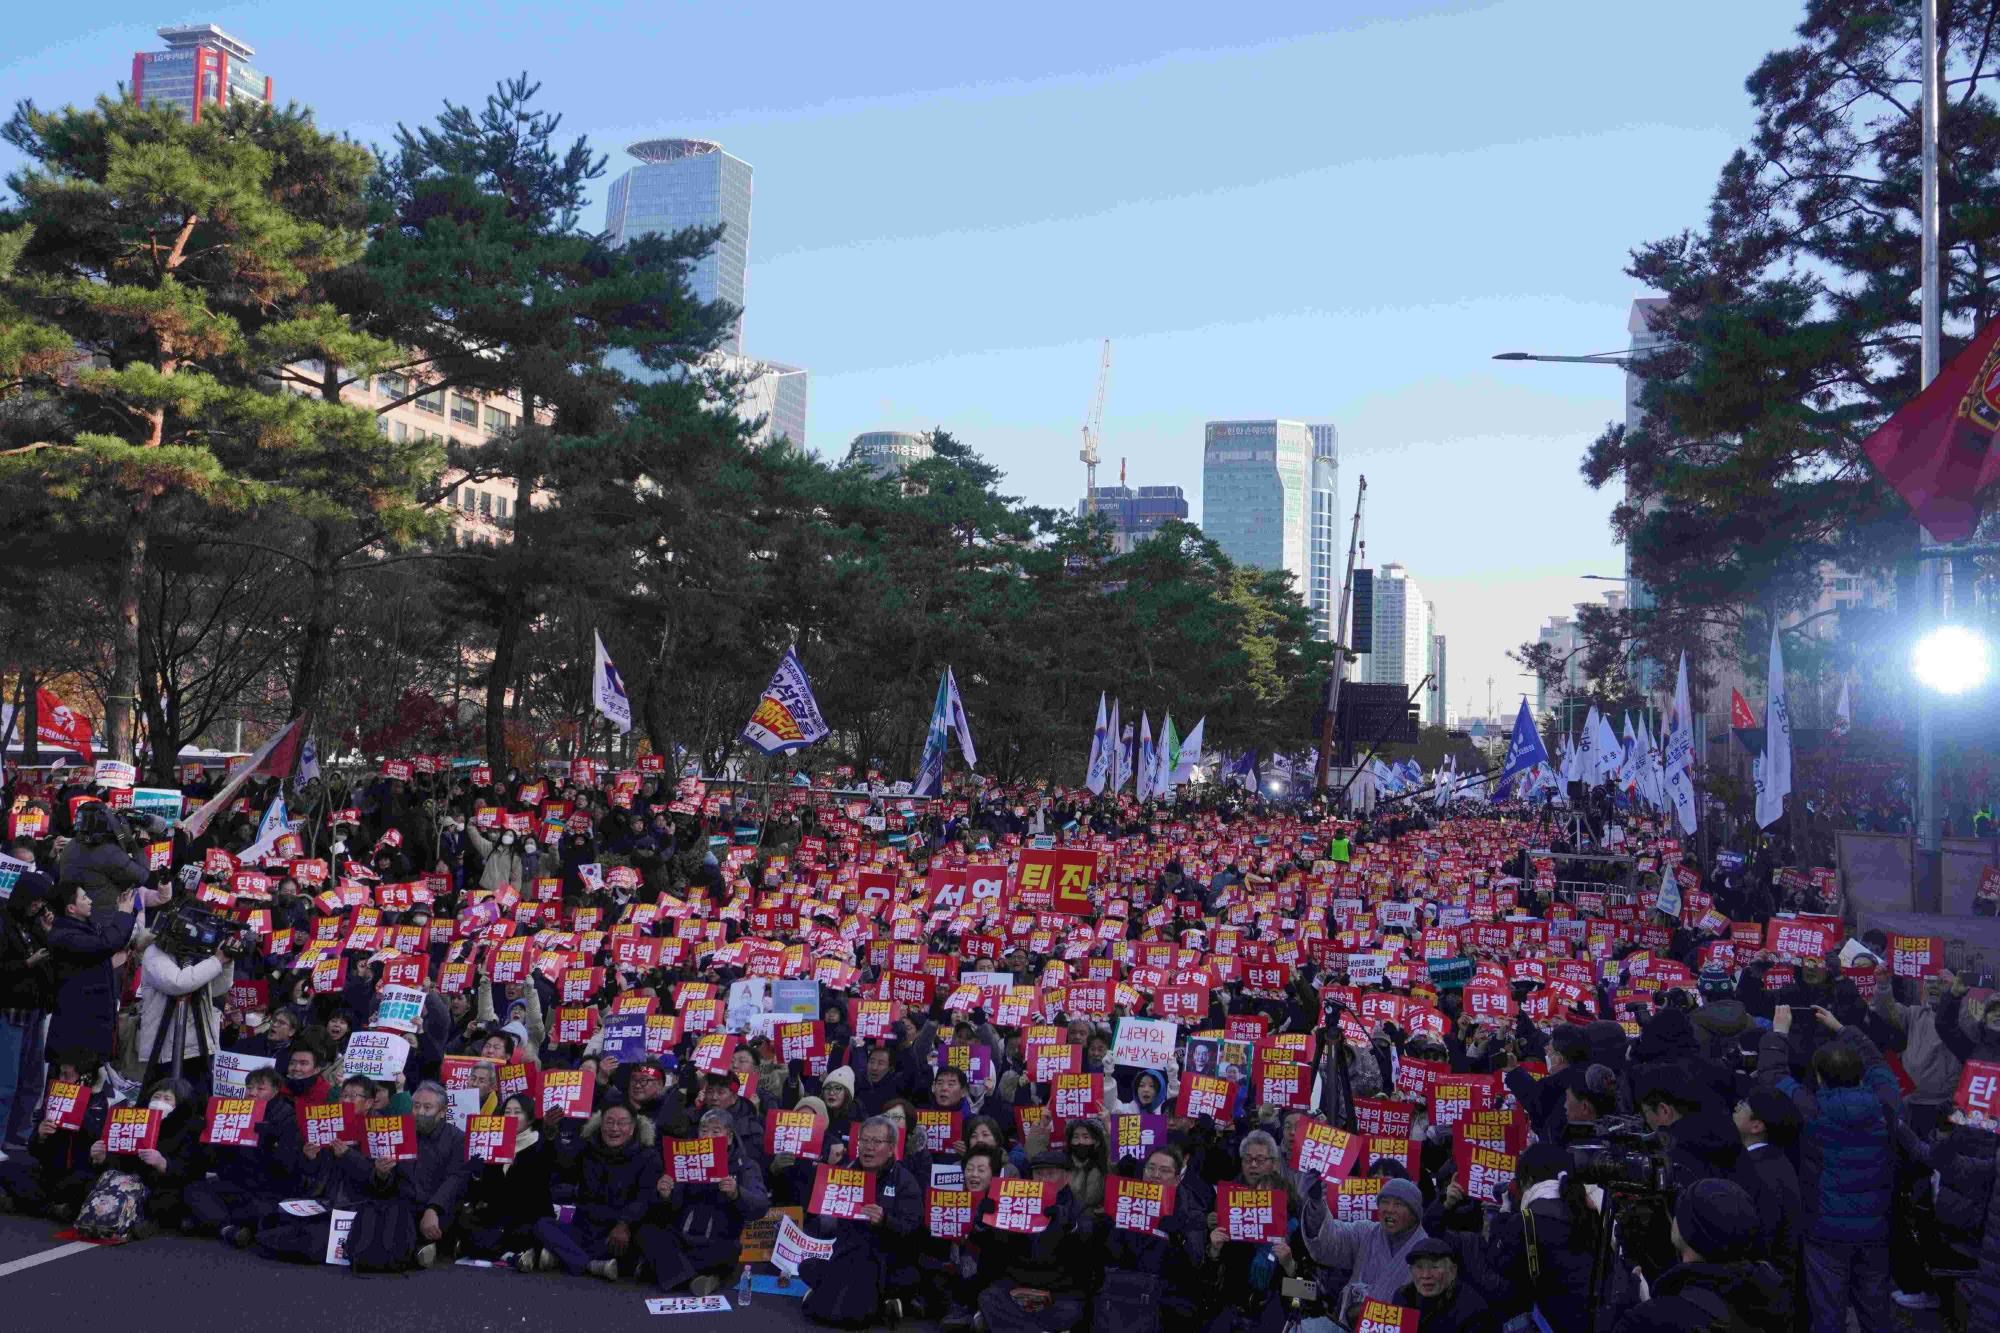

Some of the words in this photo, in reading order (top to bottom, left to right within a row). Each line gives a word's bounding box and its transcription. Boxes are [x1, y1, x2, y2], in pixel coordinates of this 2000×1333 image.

[295, 864, 321, 878] 탄핵
[236, 877, 265, 891] 탄핵
[1021, 864, 1093, 901] 퇴진
[382, 889, 407, 903] 탄핵
[774, 915, 794, 928] 탄핵
[1041, 916, 1064, 929] 탄핵
[398, 926, 422, 935] 내란죄
[1068, 928, 1091, 941] 탄핵
[1478, 928, 1507, 937] 윤석열을
[1778, 927, 1824, 944] 윤석열을
[397, 934, 421, 944] 윤석열
[661, 936, 682, 947] 내란죄
[1478, 936, 1507, 945] 탄핵하라
[1894, 937, 1930, 951] 내란죄
[396, 943, 413, 953] 탄핵!
[619, 943, 652, 959] 탄핵
[895, 944, 920, 955] 내란죄
[965, 941, 995, 956] 탄핵
[1777, 940, 1822, 956] 탄핵하라
[496, 951, 521, 962] 내란죄
[894, 955, 920, 964] 윤석열
[1893, 950, 1930, 965] 윤석열
[314, 960, 340, 973] 내란죄
[442, 962, 468, 973] 내란죄
[494, 962, 521, 972] 윤석열
[816, 959, 842, 971] 내란죄
[1515, 962, 1543, 976] 탄핵
[1893, 963, 1921, 978] 탄핵!
[313, 971, 338, 984] 윤석열
[389, 965, 419, 982] 탄핵
[442, 972, 467, 984] 윤석열
[494, 971, 514, 982] 탄핵!
[565, 969, 592, 980] 내란죄
[814, 969, 839, 980] 윤석열
[1132, 971, 1161, 986] 탄핵
[1176, 971, 1207, 986] 탄핵
[1249, 971, 1281, 988] 탄핵
[1350, 968, 1385, 979] 처벌하라
[313, 981, 332, 992] 탄핵!
[441, 983, 460, 993] 탄핵!
[564, 980, 590, 991] 윤석열
[680, 982, 709, 992] 내란죄
[1550, 981, 1581, 997] 탄핵
[564, 991, 584, 1002] 탄핵!
[999, 996, 1031, 1007] 내란죄
[1068, 988, 1106, 1000] 윤석열을
[620, 997, 650, 1008] 내란죄
[687, 1000, 716, 1011] 내란죄
[857, 1001, 891, 1013] 내란죄
[1067, 999, 1107, 1013] 탄핵하라
[1162, 993, 1199, 1013] 탄핵
[1362, 1000, 1395, 1016] 탄핵
[1471, 993, 1508, 1013] 탄핵
[560, 1008, 588, 1020] 내란죄
[685, 1010, 715, 1022] 윤석열
[998, 1005, 1029, 1017] 윤석열
[560, 1020, 587, 1032] 윤석열
[648, 1015, 674, 1028] 내란죄
[683, 1021, 707, 1032] 탄핵!
[857, 1013, 891, 1026] 윤석열
[996, 1015, 1021, 1026] 탄핵!
[1410, 1014, 1443, 1032] 탄핵
[782, 1022, 813, 1036] 내란죄
[855, 1025, 881, 1038] 탄핵!
[1119, 1027, 1165, 1045] 내려와
[351, 1035, 388, 1048] 내란수괴
[560, 1032, 581, 1043] 탄핵!
[782, 1036, 814, 1049] 윤석열
[347, 1048, 384, 1060] 윤석열을
[783, 1048, 807, 1062] 탄핵!
[948, 1046, 970, 1058] 퇴진
[1037, 1044, 1072, 1059] 내란죄
[1262, 1048, 1293, 1061] 내란죄
[216, 1055, 240, 1069] 권력을
[344, 1062, 383, 1075] 탄핵하라
[1035, 1058, 1072, 1072] 윤석열
[544, 1071, 582, 1087] 내란죄
[1263, 1065, 1298, 1079] 내란죄
[1400, 1064, 1425, 1080] 촛불의
[1057, 1074, 1092, 1090] 내란죄
[1192, 1075, 1228, 1094] 내란죄
[1263, 1078, 1298, 1093] 윤석열
[215, 1083, 245, 1097] 시민에게
[544, 1086, 580, 1102] 윤석열
[1055, 1089, 1092, 1103] 윤석열
[1434, 1085, 1471, 1100] 내란죄
[216, 1099, 255, 1115] 내란죄
[1190, 1092, 1227, 1109] 윤석열
[112, 1108, 149, 1124] 내란죄
[305, 1103, 343, 1119] 내란죄
[1055, 1102, 1083, 1118] 탄핵!
[1383, 1110, 1410, 1125] 힘으로
[214, 1114, 251, 1130] 윤석열
[306, 1118, 344, 1134] 윤석열
[365, 1115, 402, 1132] 내란죄
[471, 1115, 506, 1132] 내란죄
[775, 1111, 815, 1127] 내란죄
[1118, 1115, 1141, 1129] 퇴진
[108, 1124, 147, 1139] 윤석열
[211, 1127, 240, 1144] 탄핵!
[774, 1126, 812, 1142] 윤석열
[1118, 1129, 1154, 1146] 광장을
[1305, 1123, 1350, 1148] 내란죄
[1382, 1123, 1409, 1138] 지키자
[107, 1138, 137, 1153] 탄핵!
[367, 1131, 404, 1146] 윤석열
[470, 1131, 503, 1146] 윤석열
[672, 1138, 714, 1154] 내란죄
[773, 1139, 802, 1155] 탄핵!
[1302, 1141, 1344, 1165] 윤석열
[1368, 1138, 1409, 1155] 내란죄
[674, 1153, 714, 1169] 윤석열
[1472, 1149, 1516, 1170] 내란죄
[675, 1168, 706, 1183] 탄핵!
[826, 1168, 865, 1185] 내란죄
[824, 1184, 863, 1202] 윤석열
[1000, 1180, 1043, 1198] 내란죄
[1118, 1180, 1163, 1200] 내란죄
[931, 1190, 971, 1208] 내란죄
[997, 1197, 1041, 1215] 윤석열
[1116, 1196, 1160, 1217] 윤석열
[1229, 1190, 1272, 1208] 내란죄
[820, 1199, 853, 1217] 탄핵!
[930, 1207, 970, 1223] 윤석열
[996, 1213, 1031, 1231] 탄핵!
[1115, 1213, 1150, 1232] 탄핵!
[1229, 1207, 1272, 1225] 윤석열
[931, 1221, 961, 1237] 탄핵!
[1229, 1224, 1264, 1242] 탄핵!
[1363, 1300, 1403, 1322] 내란죄
